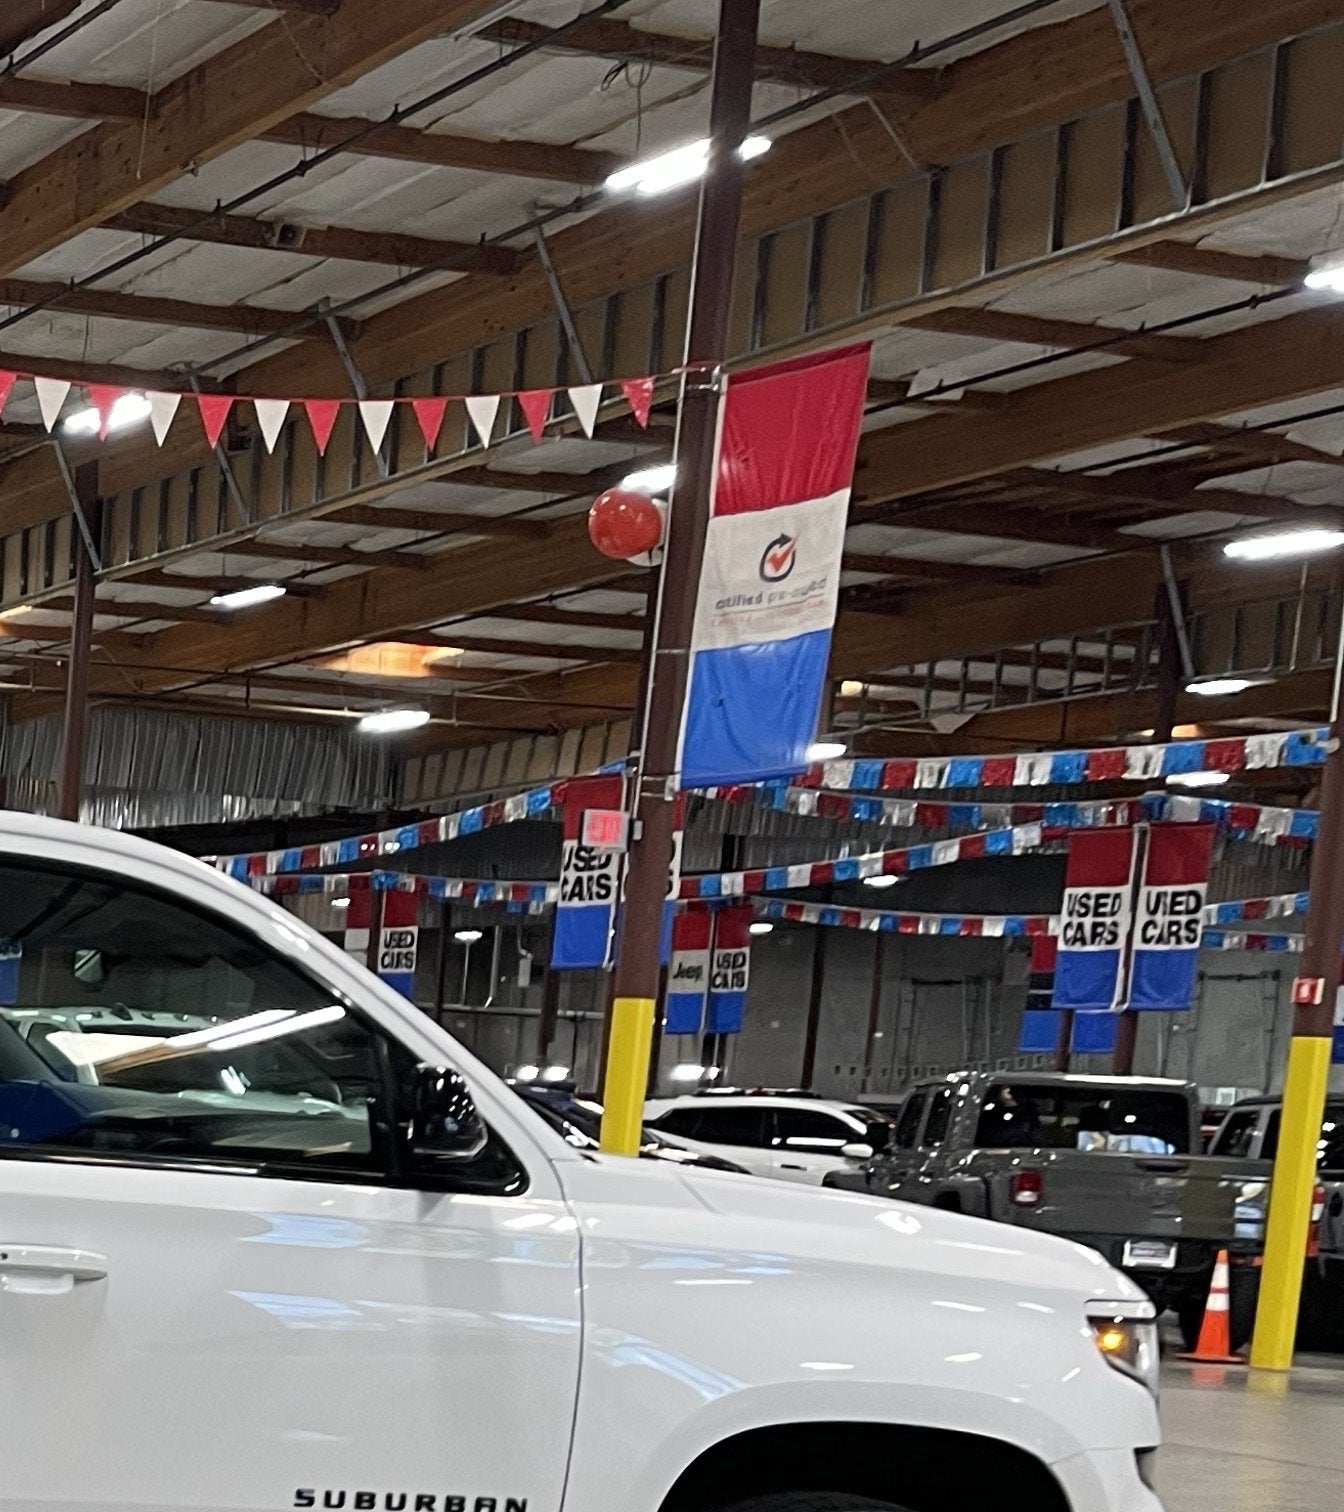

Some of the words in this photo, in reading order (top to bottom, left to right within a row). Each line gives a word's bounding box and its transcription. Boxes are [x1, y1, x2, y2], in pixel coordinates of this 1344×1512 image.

[561, 873, 612, 902] CARS
[1067, 892, 1123, 918] USED
[1064, 920, 1120, 947] CARS
[1141, 918, 1200, 946] CARS
